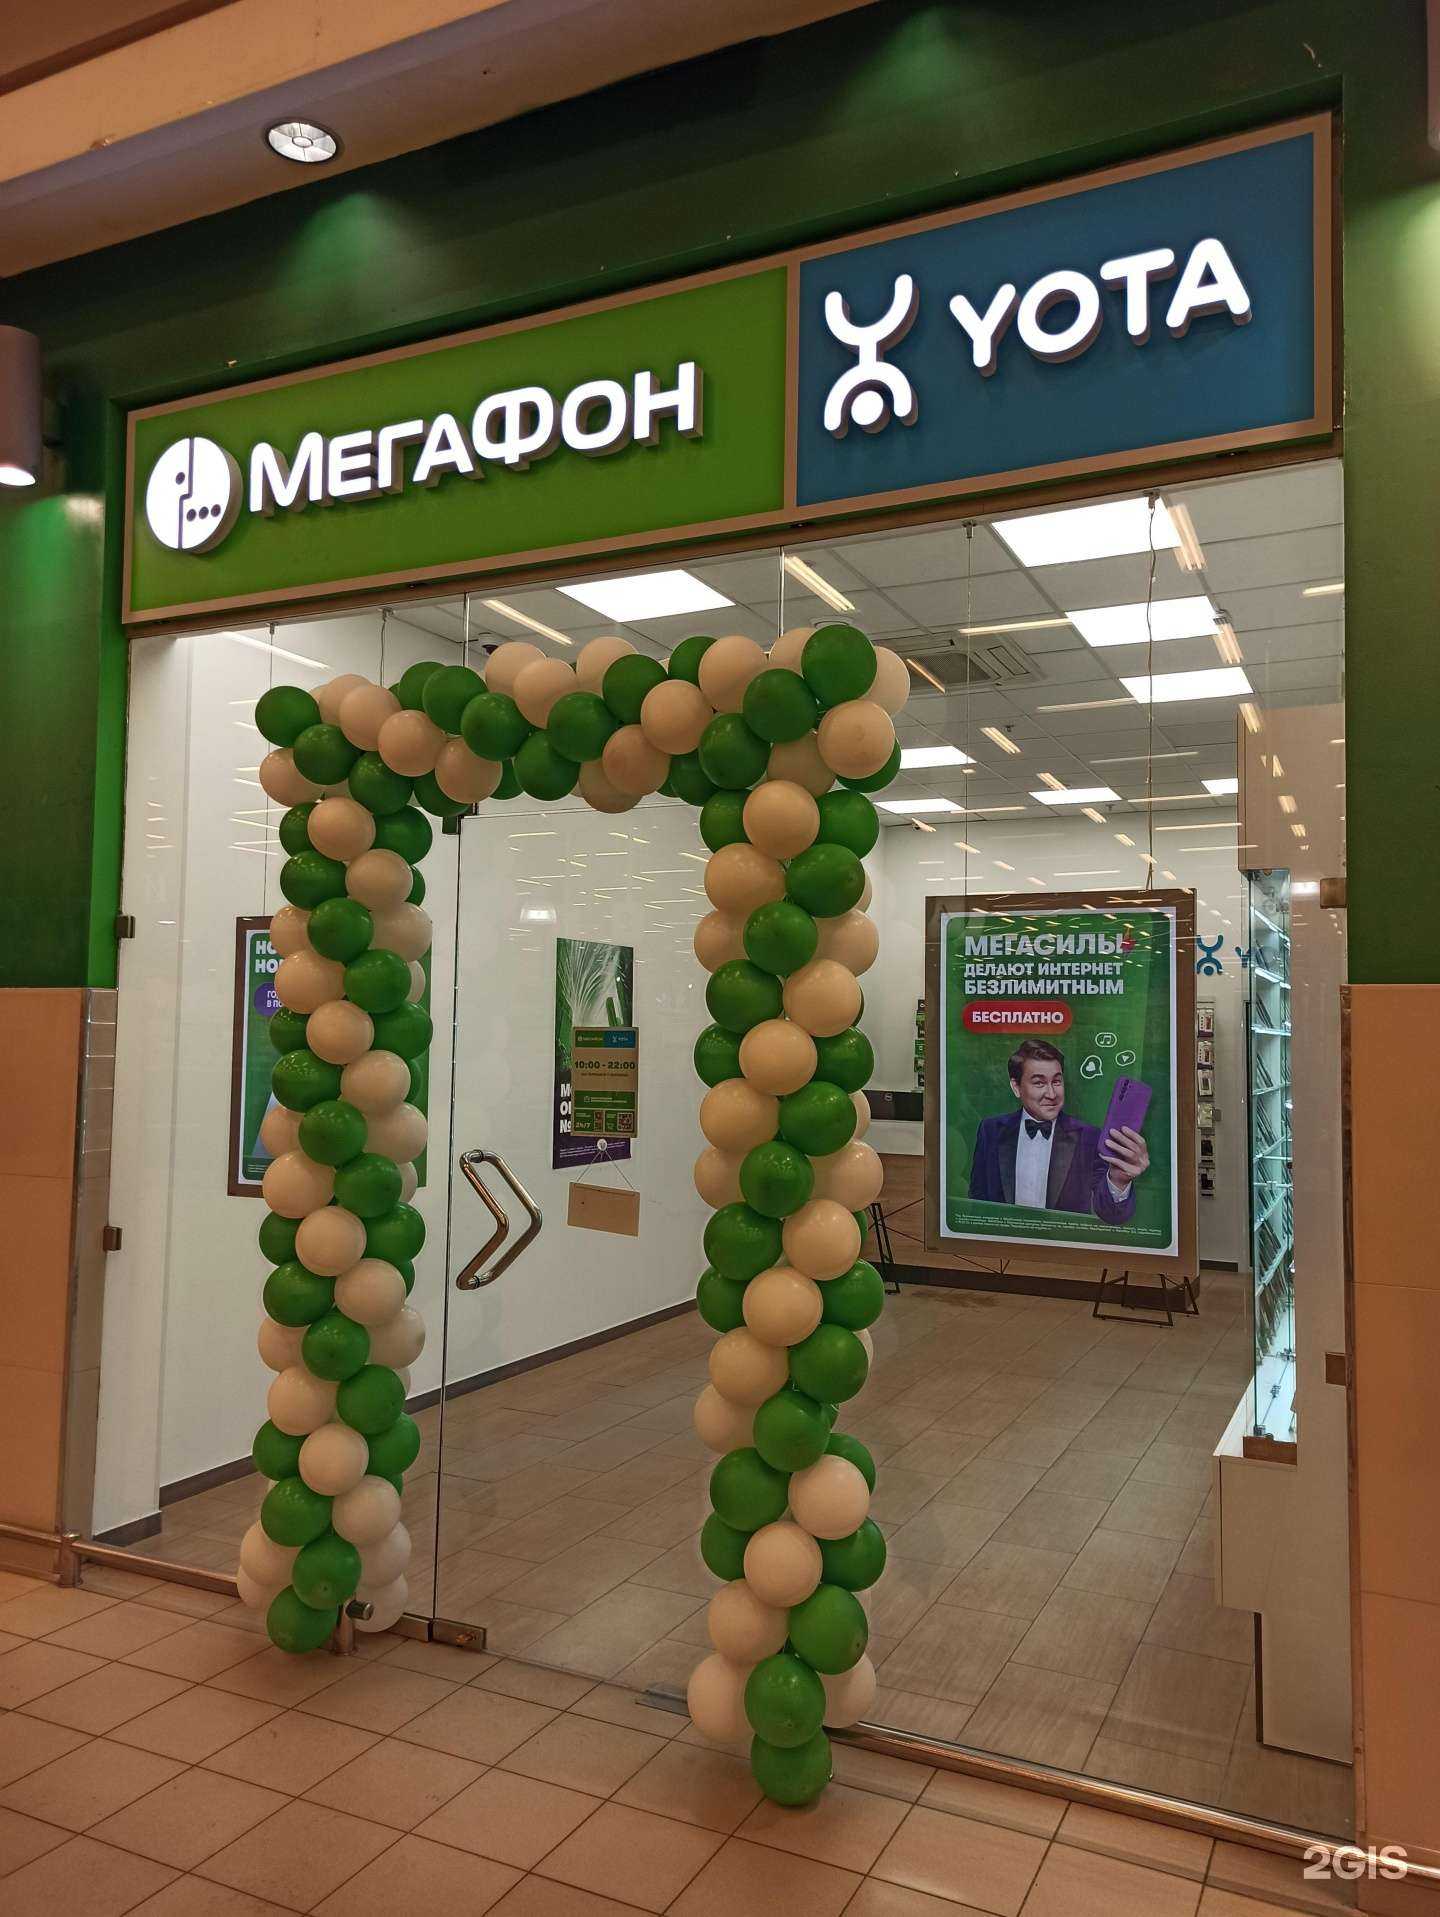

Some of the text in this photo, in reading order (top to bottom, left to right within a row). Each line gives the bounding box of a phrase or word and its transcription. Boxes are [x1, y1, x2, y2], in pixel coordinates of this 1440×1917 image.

[948, 237, 1252, 369] YOTA
[248, 360, 698, 514] МЕГАФОН
[964, 932, 1124, 957] МЕГАСИЛЫ
[254, 958, 284, 974] НО
[963, 961, 1124, 978] ДЕЛАЮТ ИНТЕРНЕТ
[964, 979, 1124, 996] БЕЗЛИМИТНЫМ
[972, 1010, 1064, 1025] БЕСПЛАТНО
[574, 1060, 601, 1070] 10:00
[607, 1061, 636, 1071] 22:00
